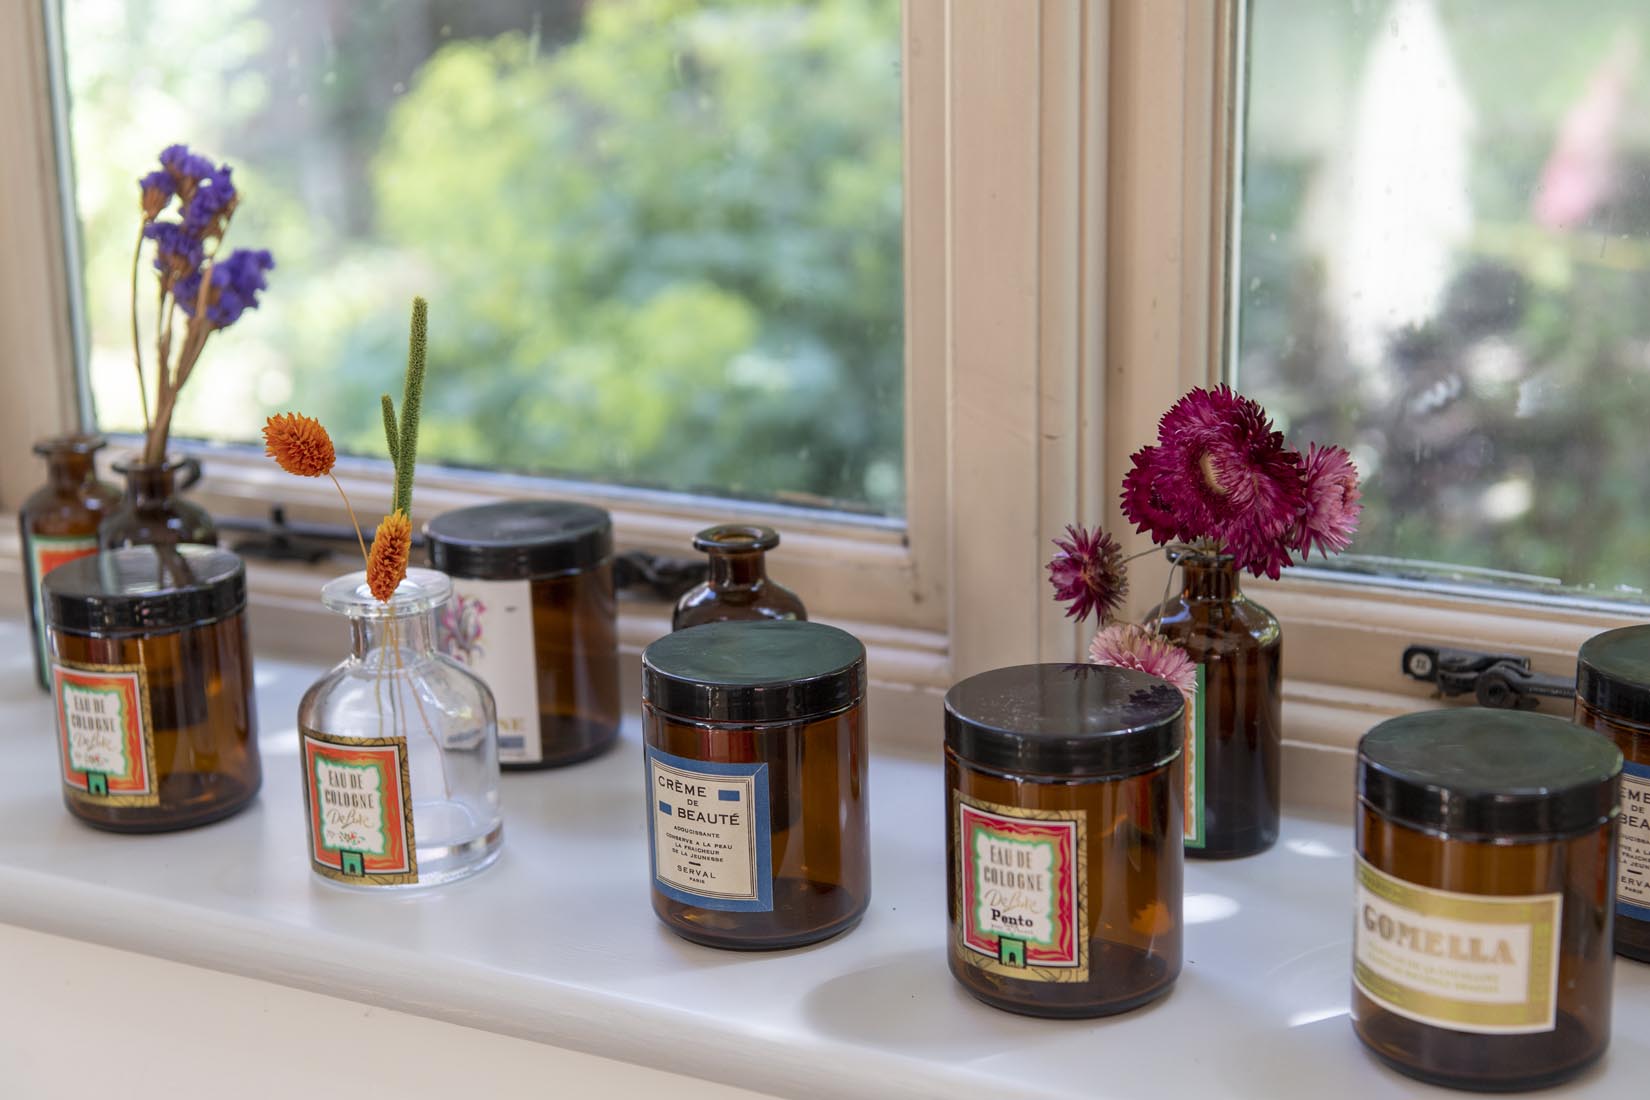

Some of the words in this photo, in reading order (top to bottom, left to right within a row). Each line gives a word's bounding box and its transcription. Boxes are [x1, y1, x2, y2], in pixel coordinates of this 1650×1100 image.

[328, 770, 347, 788] EAU
[350, 773, 364, 790] DE
[658, 775, 707, 798] CRÈME
[325, 788, 374, 809] COLOGNE
[687, 798, 699, 807] DE
[677, 807, 740, 826] BEAUTÉ
[1631, 804, 1645, 814] DE
[1618, 813, 1650, 831] BEA
[665, 832, 693, 845] CONSERVE
[674, 825, 720, 839] ADOUCISSANTE
[690, 853, 724, 863] JEUNESSE
[990, 845, 1011, 867] EAU
[1017, 851, 1032, 869] DE
[677, 864, 716, 879] SERVAL
[984, 866, 1043, 892] COLOGNE
[1621, 876, 1650, 889] ERVA
[991, 908, 1034, 928] Pento
[1363, 902, 1516, 967] GOMELLA
